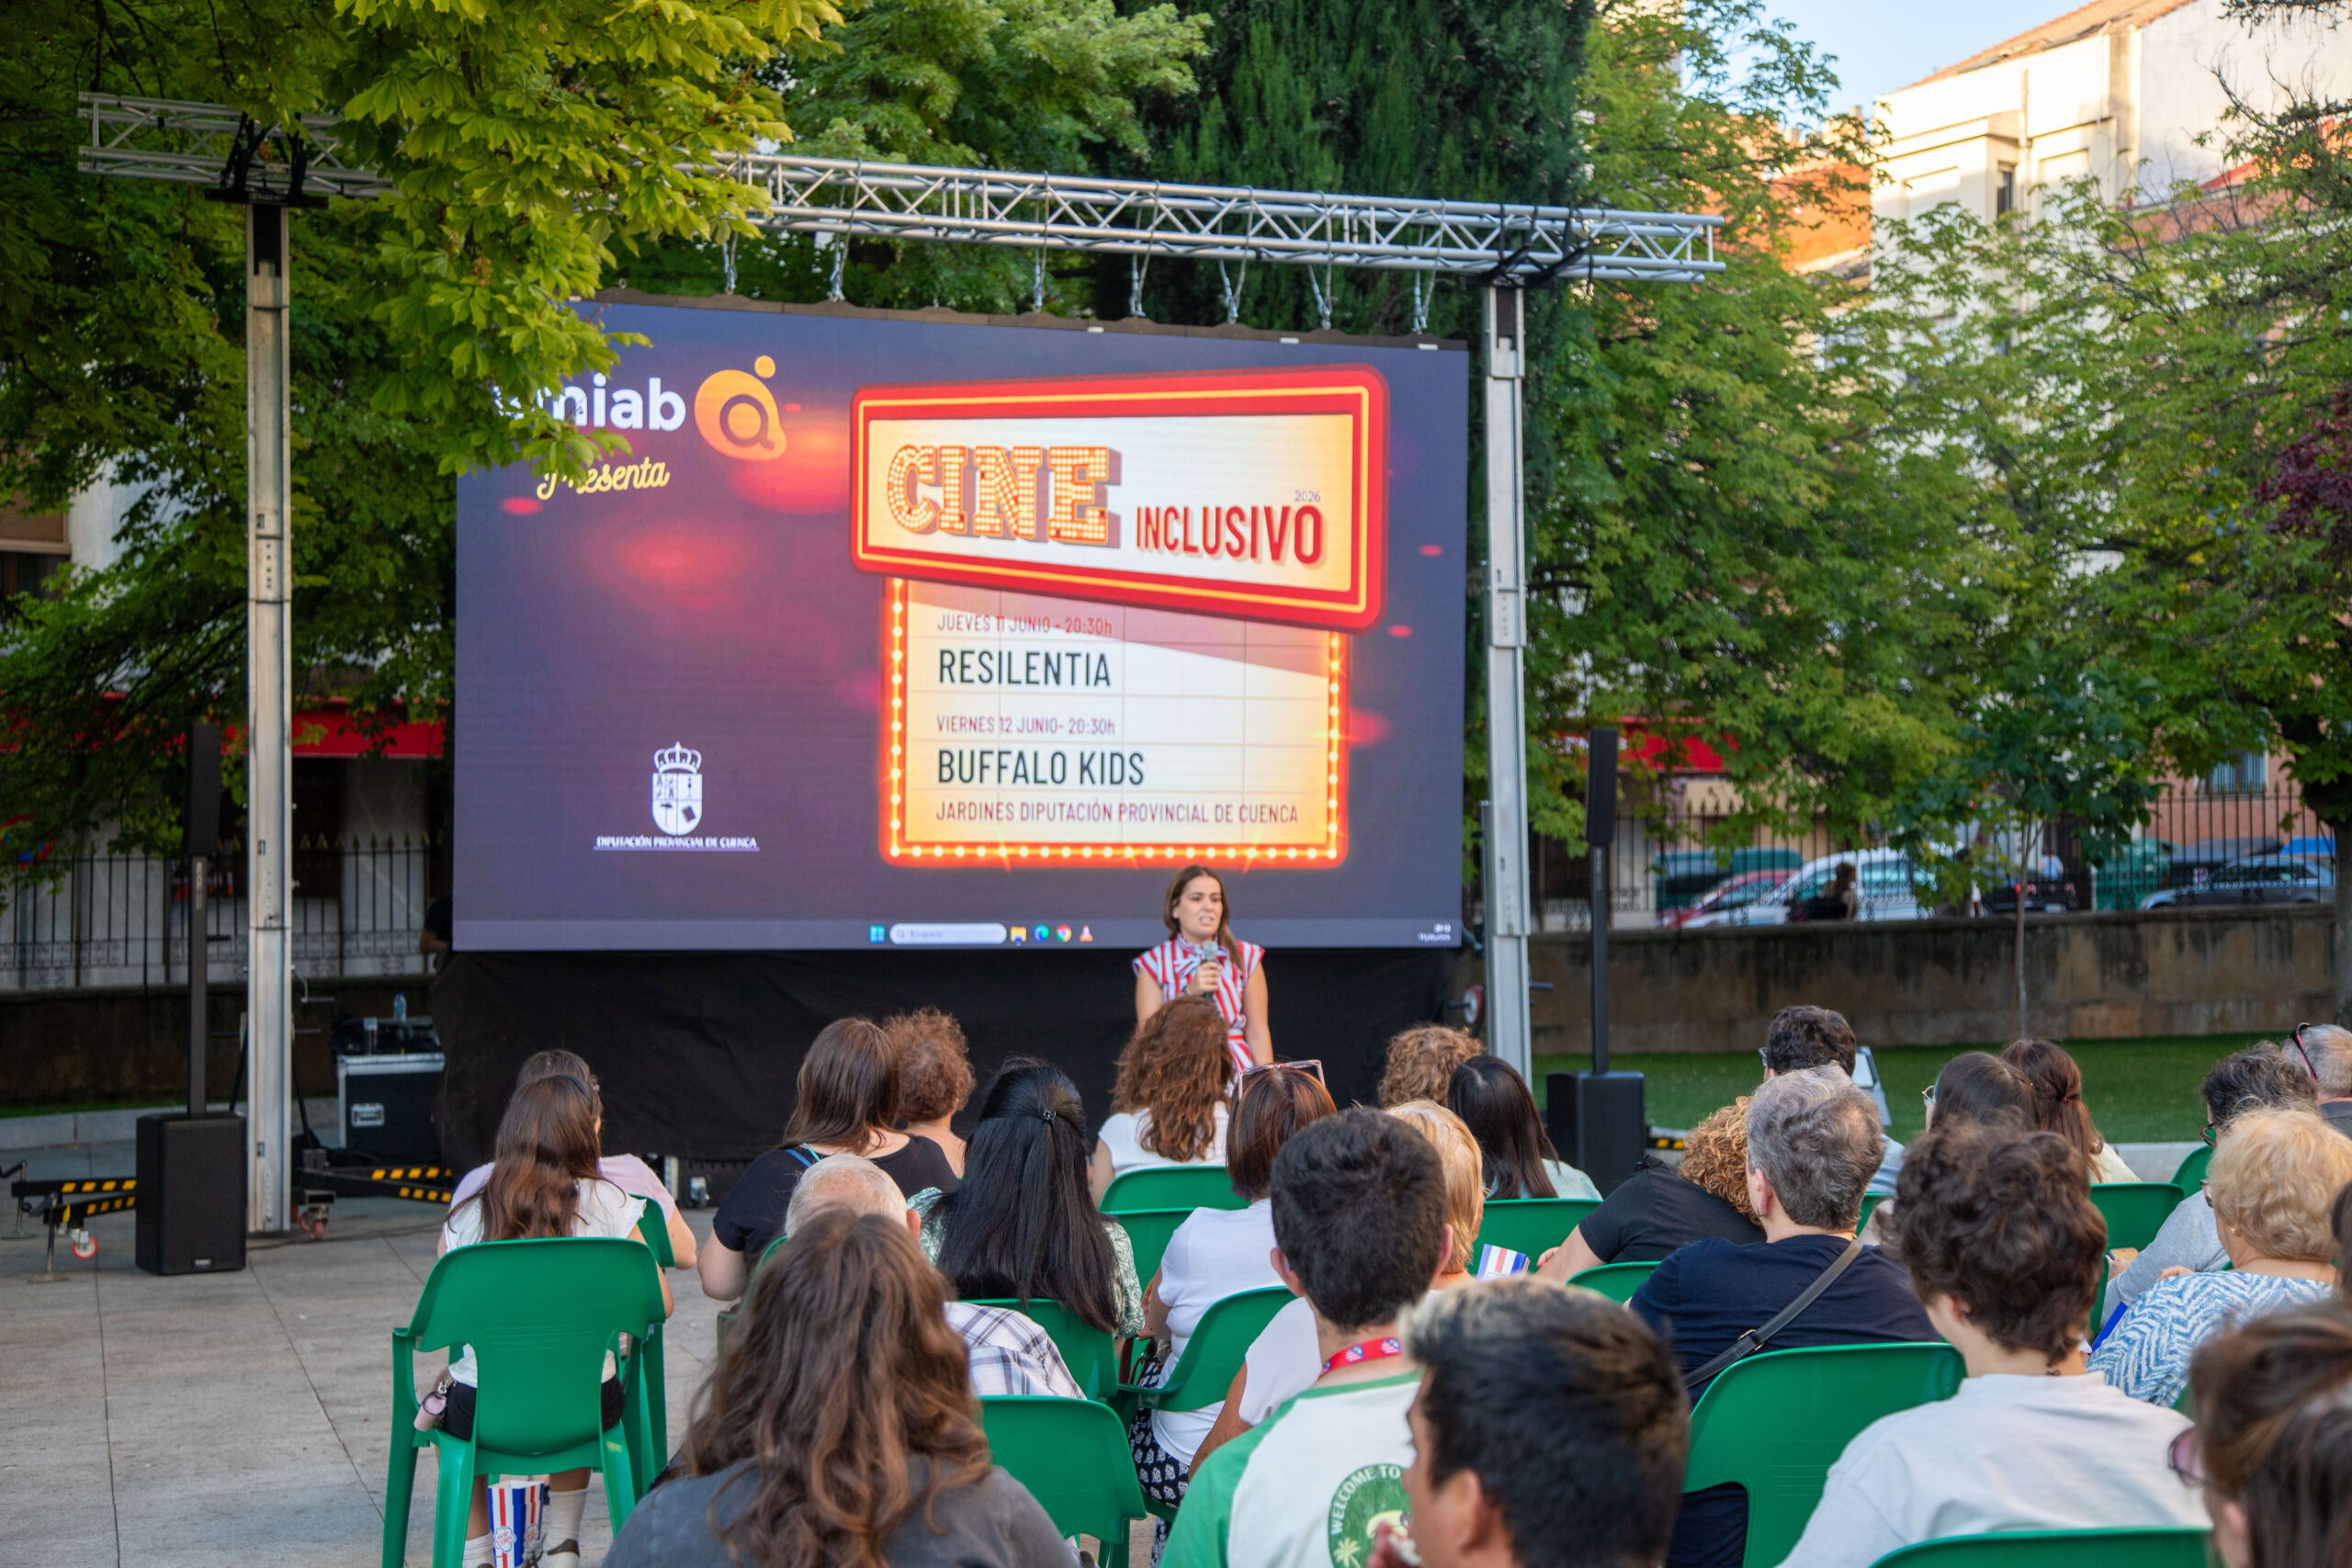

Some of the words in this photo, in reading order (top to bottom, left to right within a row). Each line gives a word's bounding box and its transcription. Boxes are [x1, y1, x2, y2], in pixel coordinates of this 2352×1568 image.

[536, 456, 671, 502] esenta
[887, 444, 1115, 546] CINE
[1294, 490, 1321, 502] 2026
[1136, 505, 1323, 565] INCLUSIVO
[937, 614, 990, 632] JUEVES
[1010, 615, 1051, 634] JUNIO
[1065, 616, 1113, 636] 20:30h
[938, 649, 1112, 687] RESILENTIA
[936, 715, 995, 733] VIERNES
[999, 716, 1012, 733] 12
[1069, 716, 1115, 735] 20:30h
[938, 750, 1067, 784] BUFFALO
[1080, 750, 1145, 785] KIDS
[936, 801, 1014, 821] JARDINES
[1020, 797, 1113, 822] DIPUTACIÓN
[1118, 803, 1209, 823] PROVINCIAL
[1215, 804, 1234, 823] DE
[1238, 804, 1299, 823] CUENCA
[1331, 1466, 1377, 1535] WELCOME
[1378, 1465, 1401, 1479] TO
